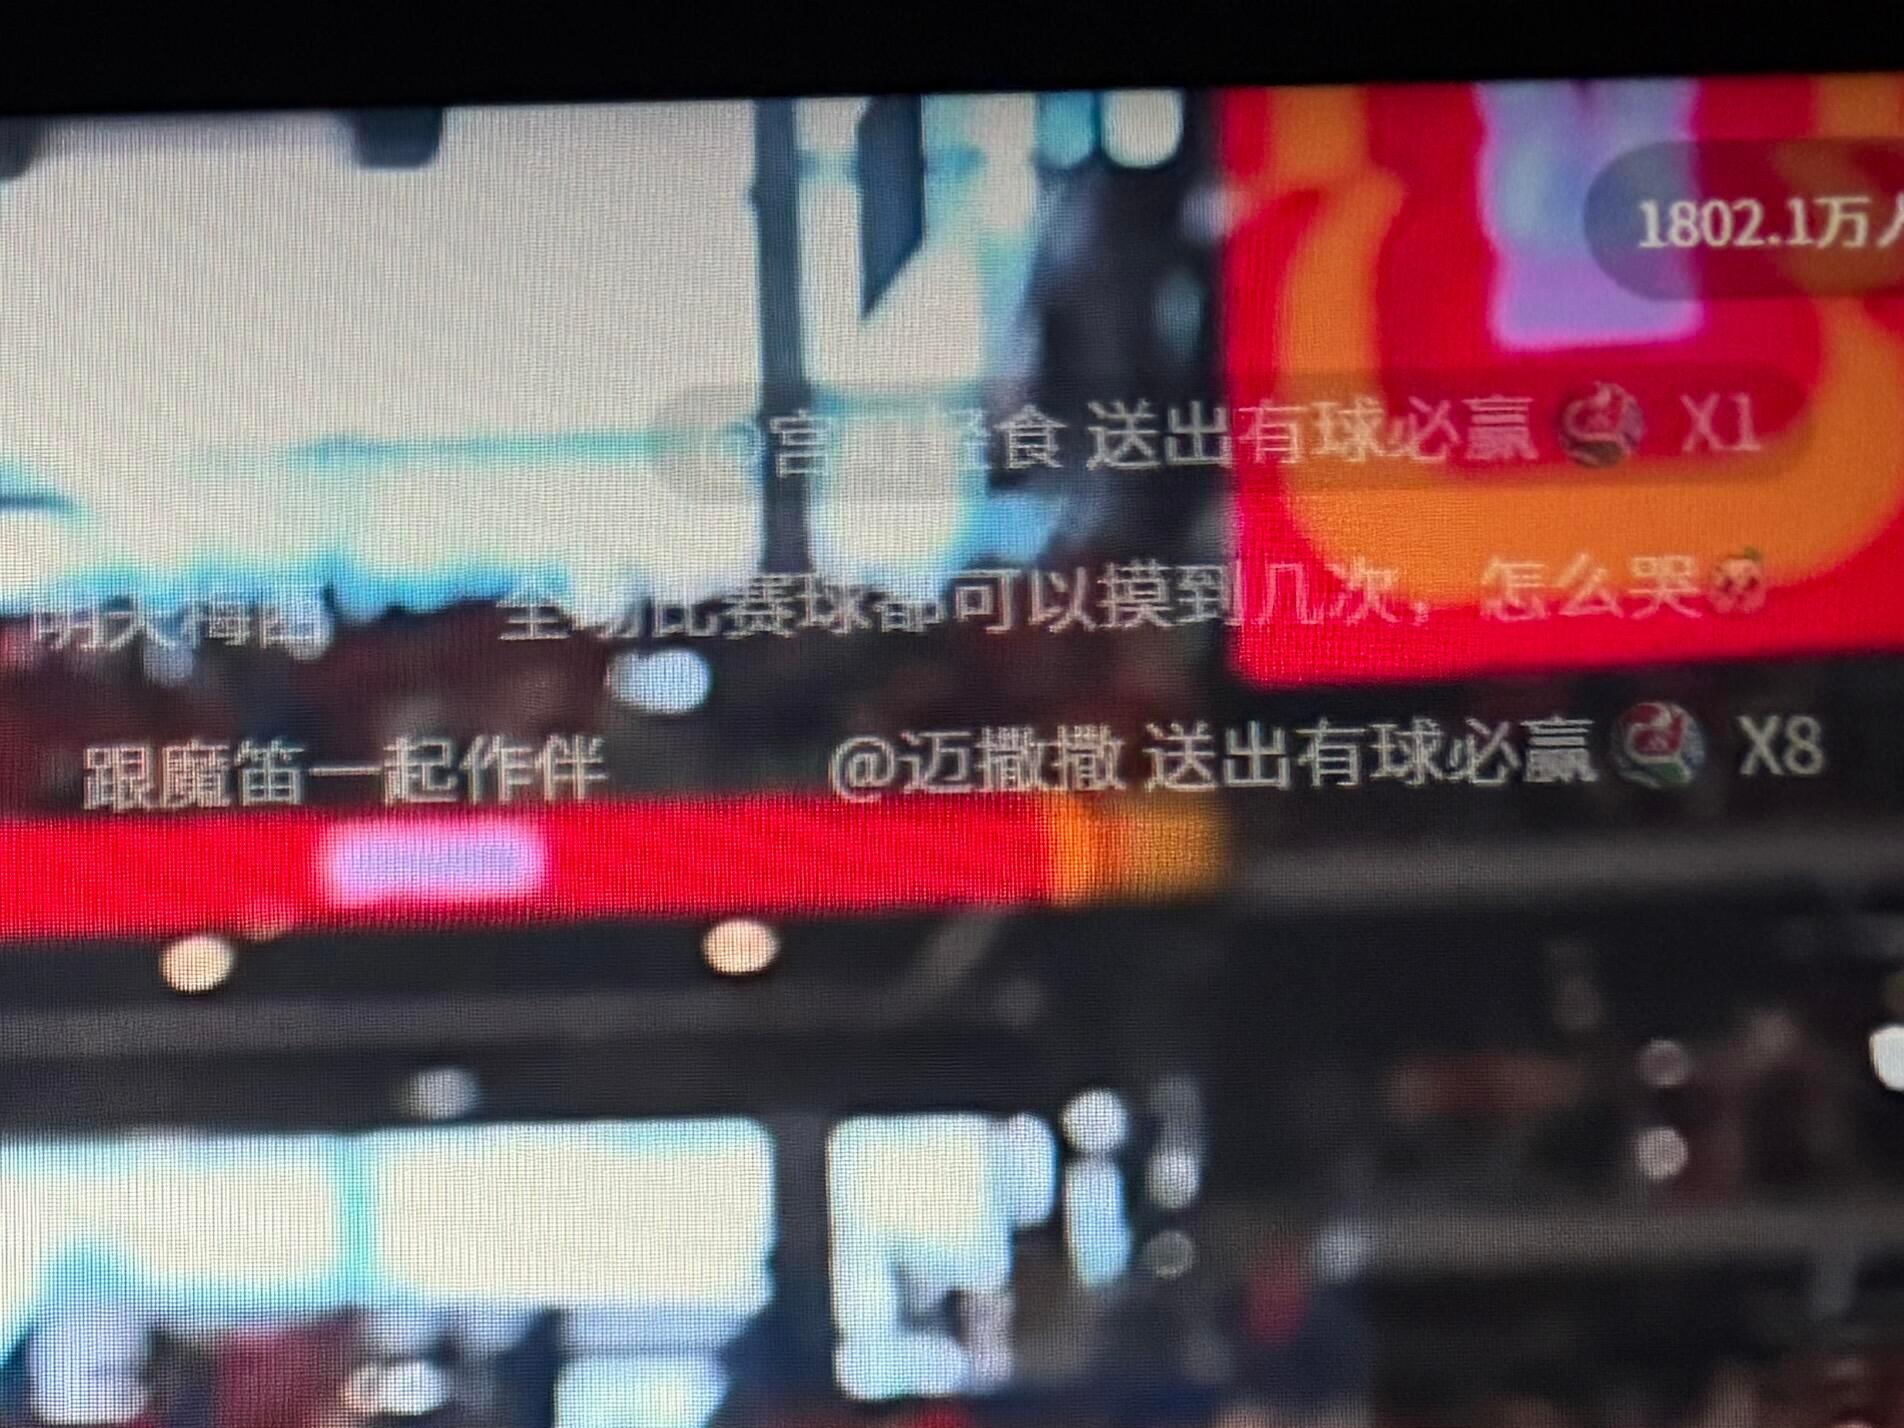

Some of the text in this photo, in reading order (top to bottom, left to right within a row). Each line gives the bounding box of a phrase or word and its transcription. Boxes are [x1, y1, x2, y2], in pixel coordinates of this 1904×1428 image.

[1086, 393, 1538, 472] 送出有球必赢
[1682, 393, 1761, 453] X1
[83, 734, 608, 813] 跟魔笛一起作伴
[1145, 714, 1599, 789] 送出有球必赢
[1739, 716, 1825, 777] X8
